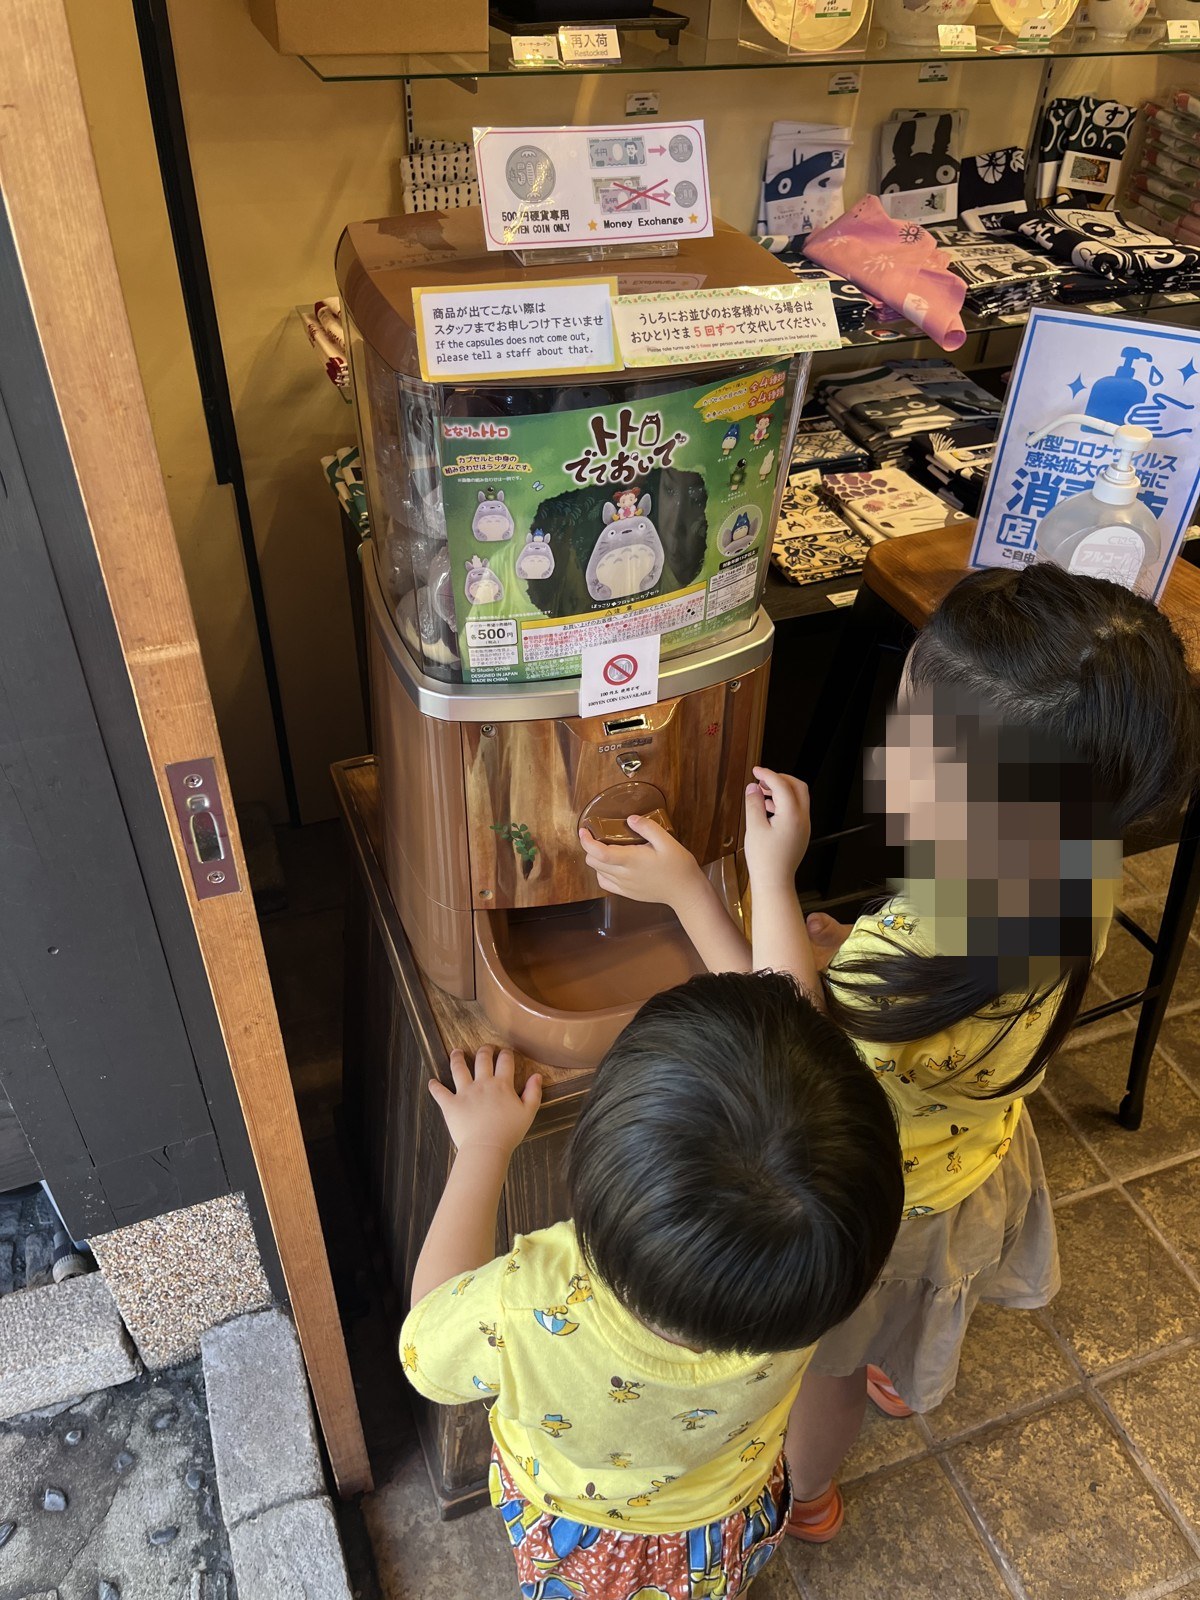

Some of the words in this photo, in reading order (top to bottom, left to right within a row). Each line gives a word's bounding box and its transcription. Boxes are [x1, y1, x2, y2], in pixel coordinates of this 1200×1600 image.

[570, 33, 607, 48] 再入荷
[574, 49, 608, 57] Restocked
[532, 224, 551, 234] COIN
[553, 223, 571, 232] ONLY
[603, 220, 632, 229] Money
[638, 217, 684, 227] Exchange
[433, 302, 546, 320] 商品が出てこない際は
[639, 300, 814, 326] うしろにお並びのお客様がいる場合は
[434, 315, 604, 335] スタッフまでお申しつけ下さいませ
[435, 340, 445, 350] If
[447, 339, 464, 349] the
[466, 337, 504, 350] capsules
[506, 335, 527, 346] does
[529, 334, 545, 344] not
[547, 334, 568, 343] come
[570, 332, 591, 342] out,
[436, 352, 469, 365] please
[472, 350, 491, 361] tell
[496, 351, 502, 359] a
[506, 347, 532, 358] staff
[536, 346, 563, 357] about
[567, 344, 594, 355] that.
[444, 423, 509, 438] となりのトトロ
[591, 409, 662, 456] トトロ
[458, 455, 517, 464] カプセルと中身の
[445, 464, 531, 475] 組み合わせはランダムです。
[1025, 451, 1170, 490] 感染拡大防に
